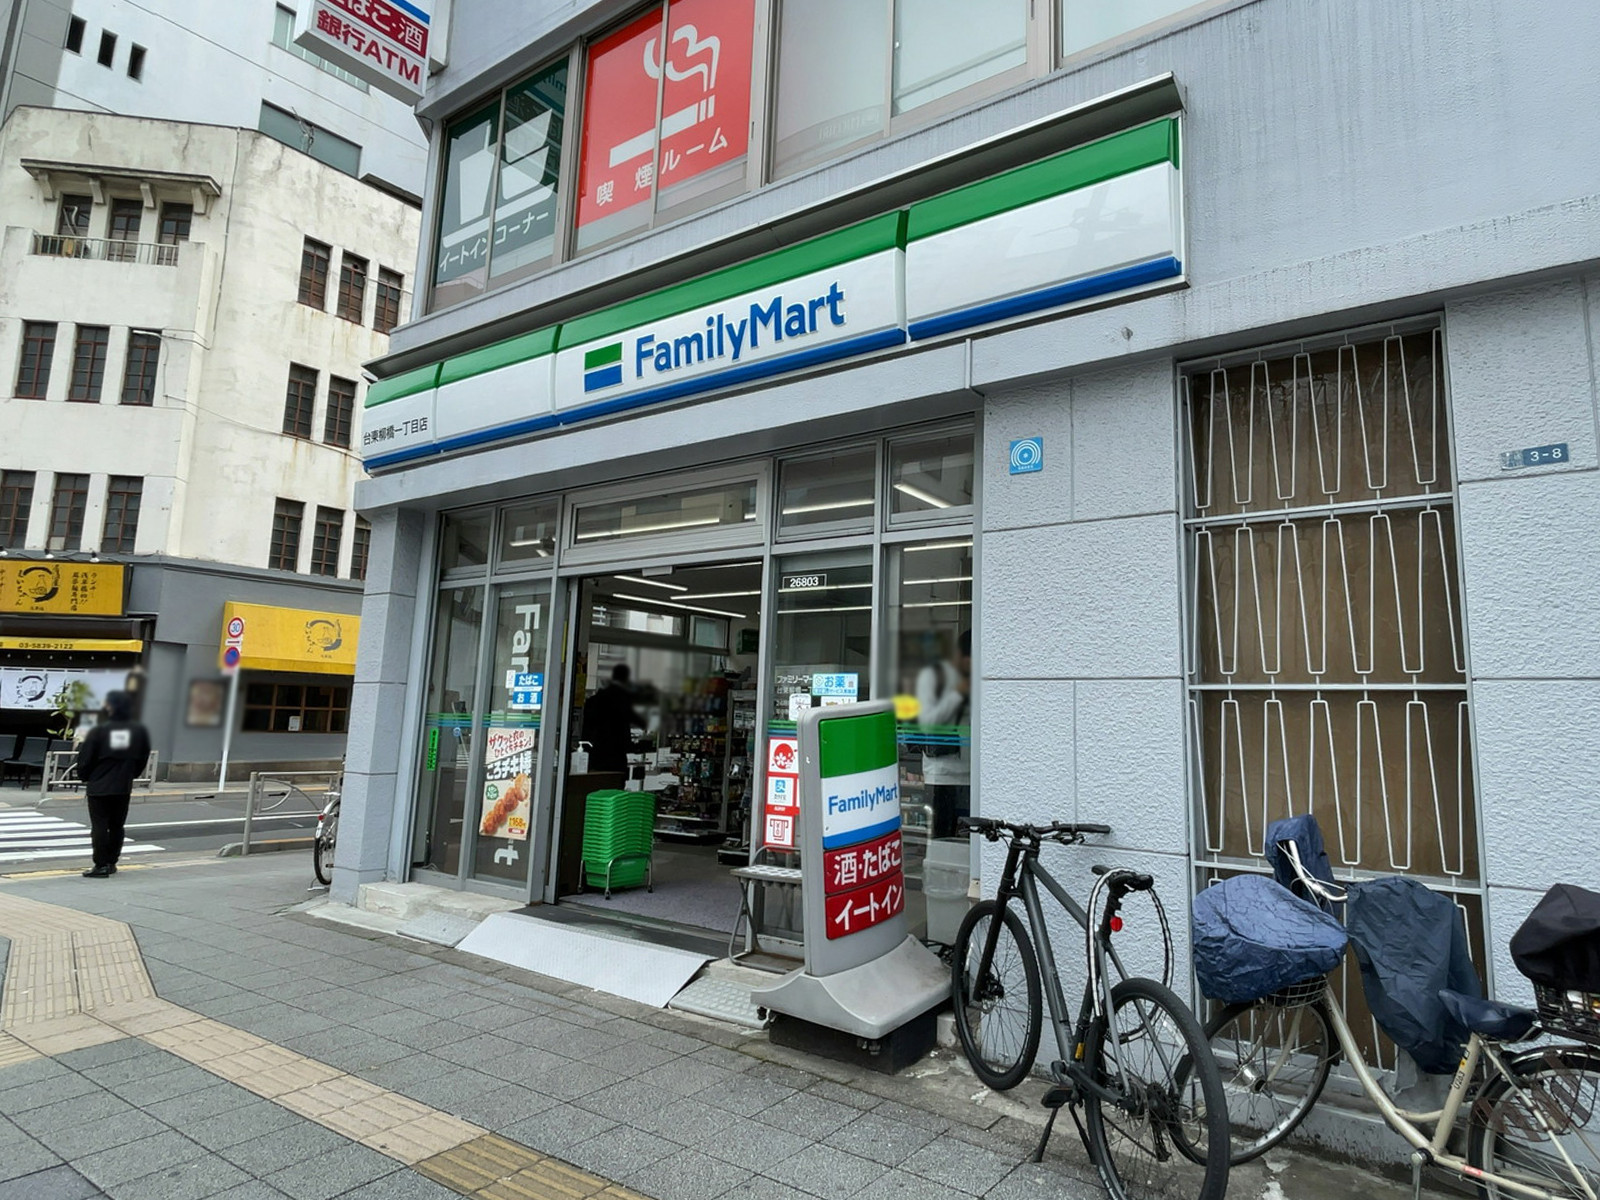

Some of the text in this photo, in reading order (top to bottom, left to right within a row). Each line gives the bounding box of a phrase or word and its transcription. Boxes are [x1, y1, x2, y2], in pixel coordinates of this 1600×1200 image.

[338, 0, 424, 52] ばこ・酒
[317, 9, 420, 85] 銀行ATM
[596, 127, 728, 207] 喫煙ルーム
[636, 281, 845, 378] FamilyMart
[363, 417, 428, 446] 台東柳橋一丁目店
[790, 576, 819, 588] 26803
[231, 621, 240, 633] 30
[518, 674, 539, 686] たばこ
[824, 675, 845, 688] お薬
[828, 783, 898, 815] FamilyMart
[834, 840, 901, 886] 酒・たばこ
[834, 884, 903, 931] イートイン
